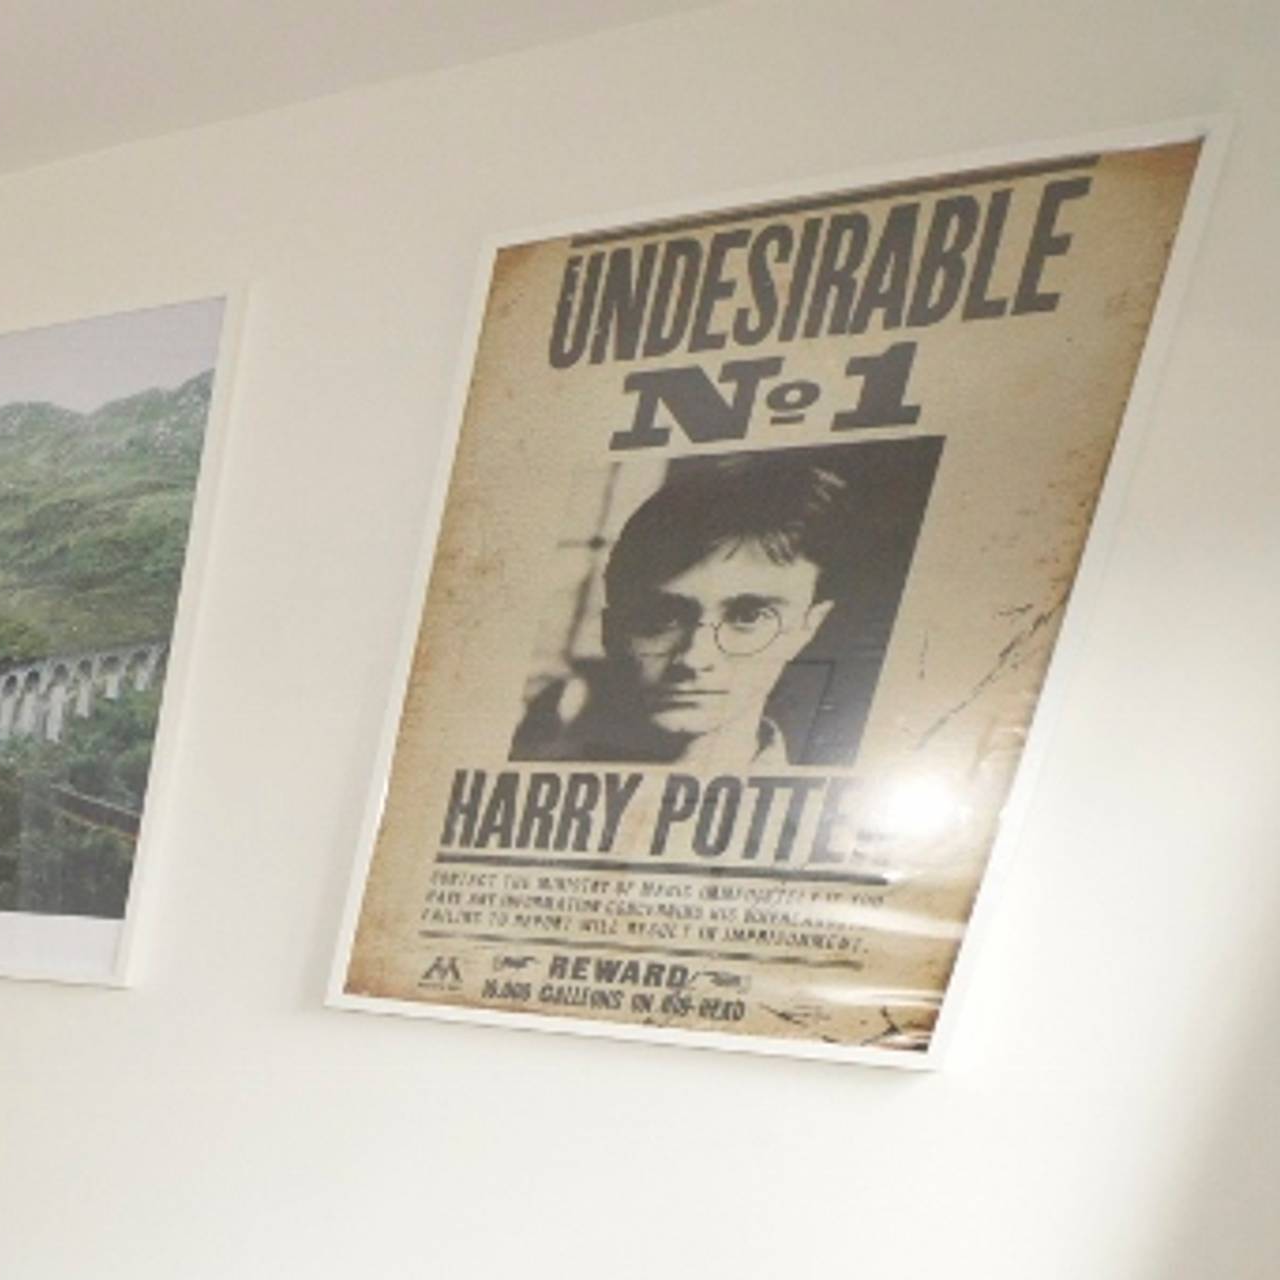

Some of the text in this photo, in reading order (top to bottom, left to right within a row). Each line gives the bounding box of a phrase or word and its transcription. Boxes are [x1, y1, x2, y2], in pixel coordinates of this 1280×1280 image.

[547, 177, 1093, 370] UNDESIRABLE
[830, 341, 923, 432] 1
[440, 769, 892, 866] HARRY POTTE
[548, 955, 689, 988] REWARD
